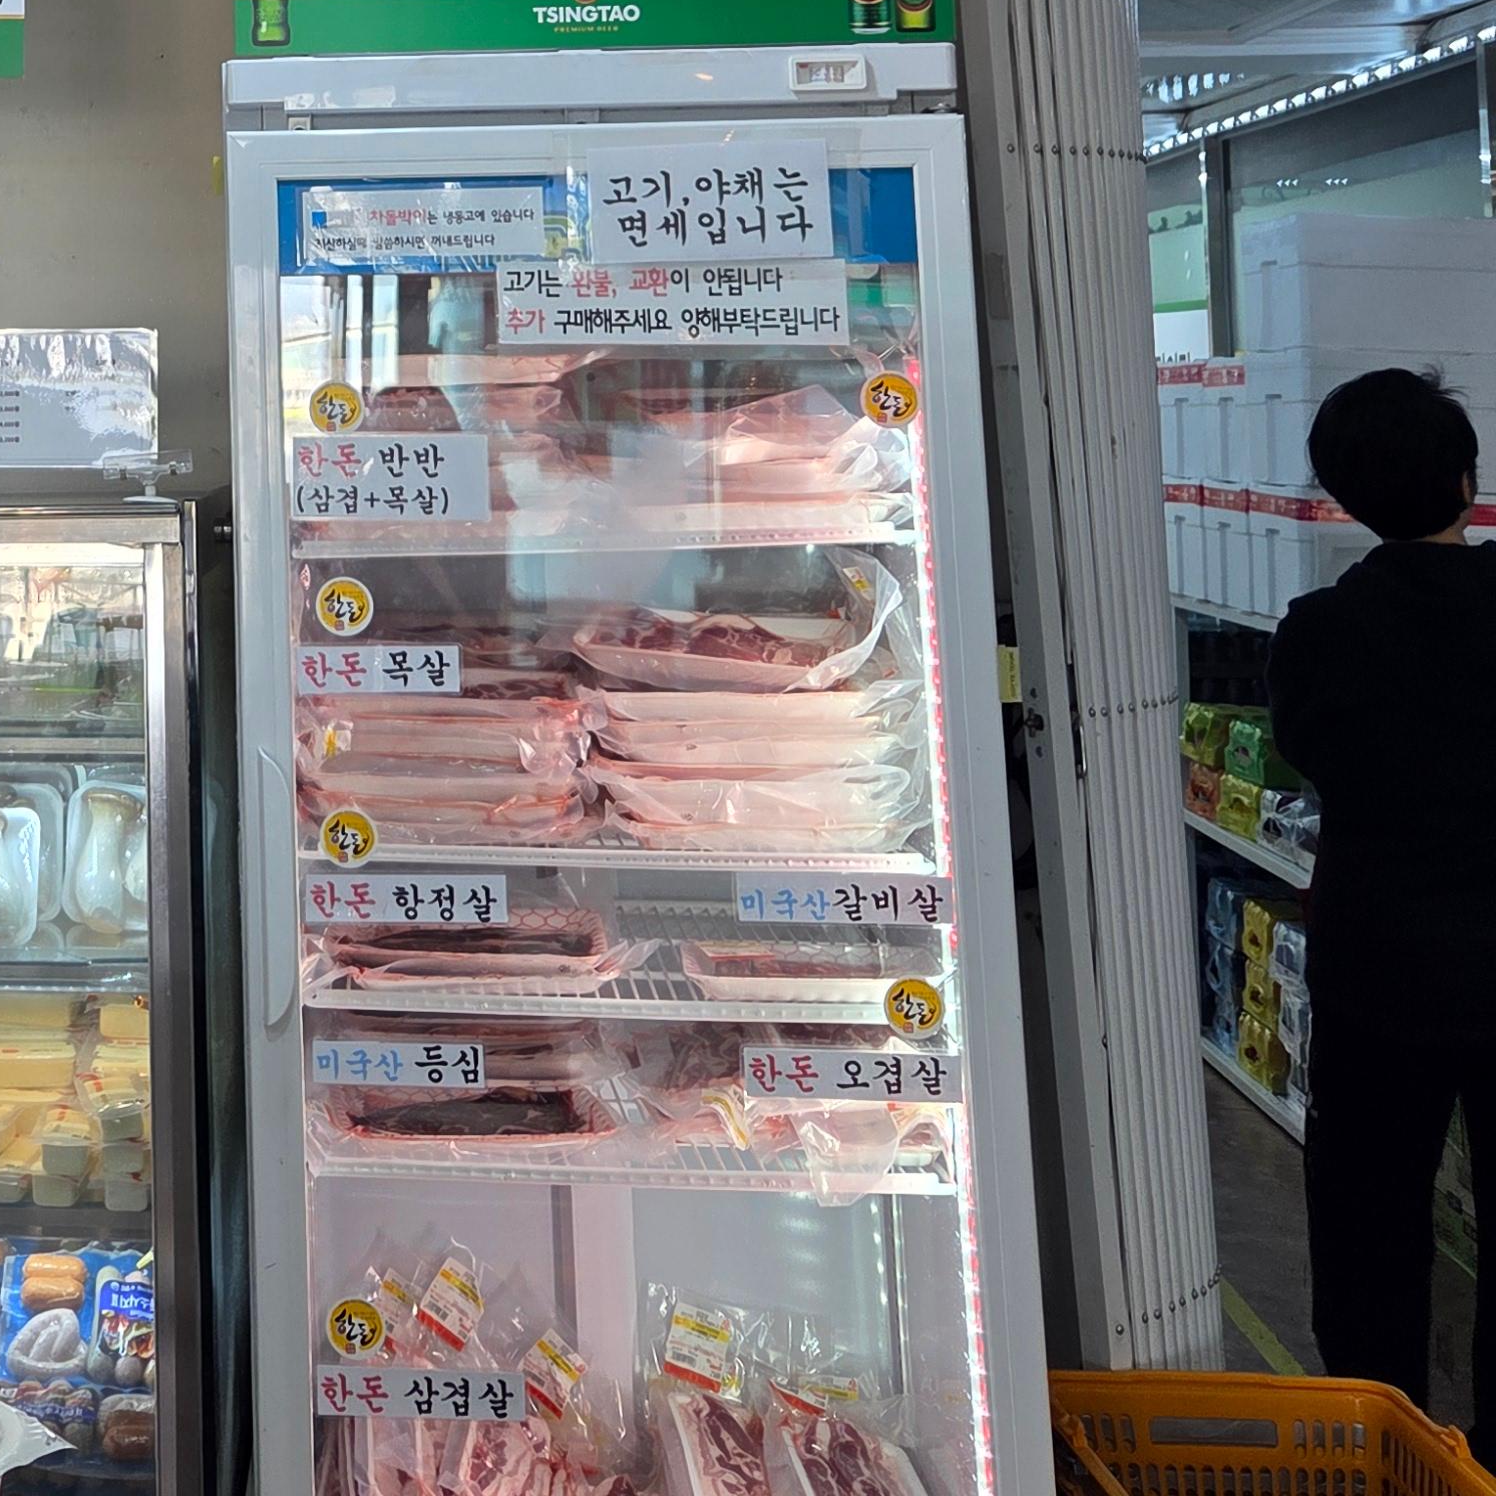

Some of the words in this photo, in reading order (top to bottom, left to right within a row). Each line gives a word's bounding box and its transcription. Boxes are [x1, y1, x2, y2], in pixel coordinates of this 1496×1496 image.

[533, 4, 640, 23] TSINGTAO
[442, 209, 486, 226] 냉동고에
[491, 207, 534, 223] 있습니다
[616, 204, 814, 248] 면세입니다
[431, 233, 495, 249] 꺼내드립니다
[503, 269, 563, 298] 고기는
[629, 267, 690, 298] 교환이
[703, 266, 783, 296] 안됩니다
[505, 308, 546, 335] 추가
[554, 307, 672, 335] 구매해주세요
[681, 306, 840, 340] 양해부탁드립니다
[298, 443, 364, 480] 한돈
[379, 441, 445, 480] 반반
[296, 483, 449, 517] (삼겹+목살)
[302, 651, 368, 687] 한돈
[382, 651, 450, 690] 목살
[310, 882, 375, 918] 한돈
[391, 883, 498, 923] 항정살
[316, 1048, 404, 1082] 미국산
[414, 1044, 481, 1086] 등심
[749, 1054, 819, 1093] 한돈
[836, 1056, 948, 1096] 오겹살
[321, 1374, 390, 1415] 한돈
[404, 1377, 515, 1419] 삼겹살
